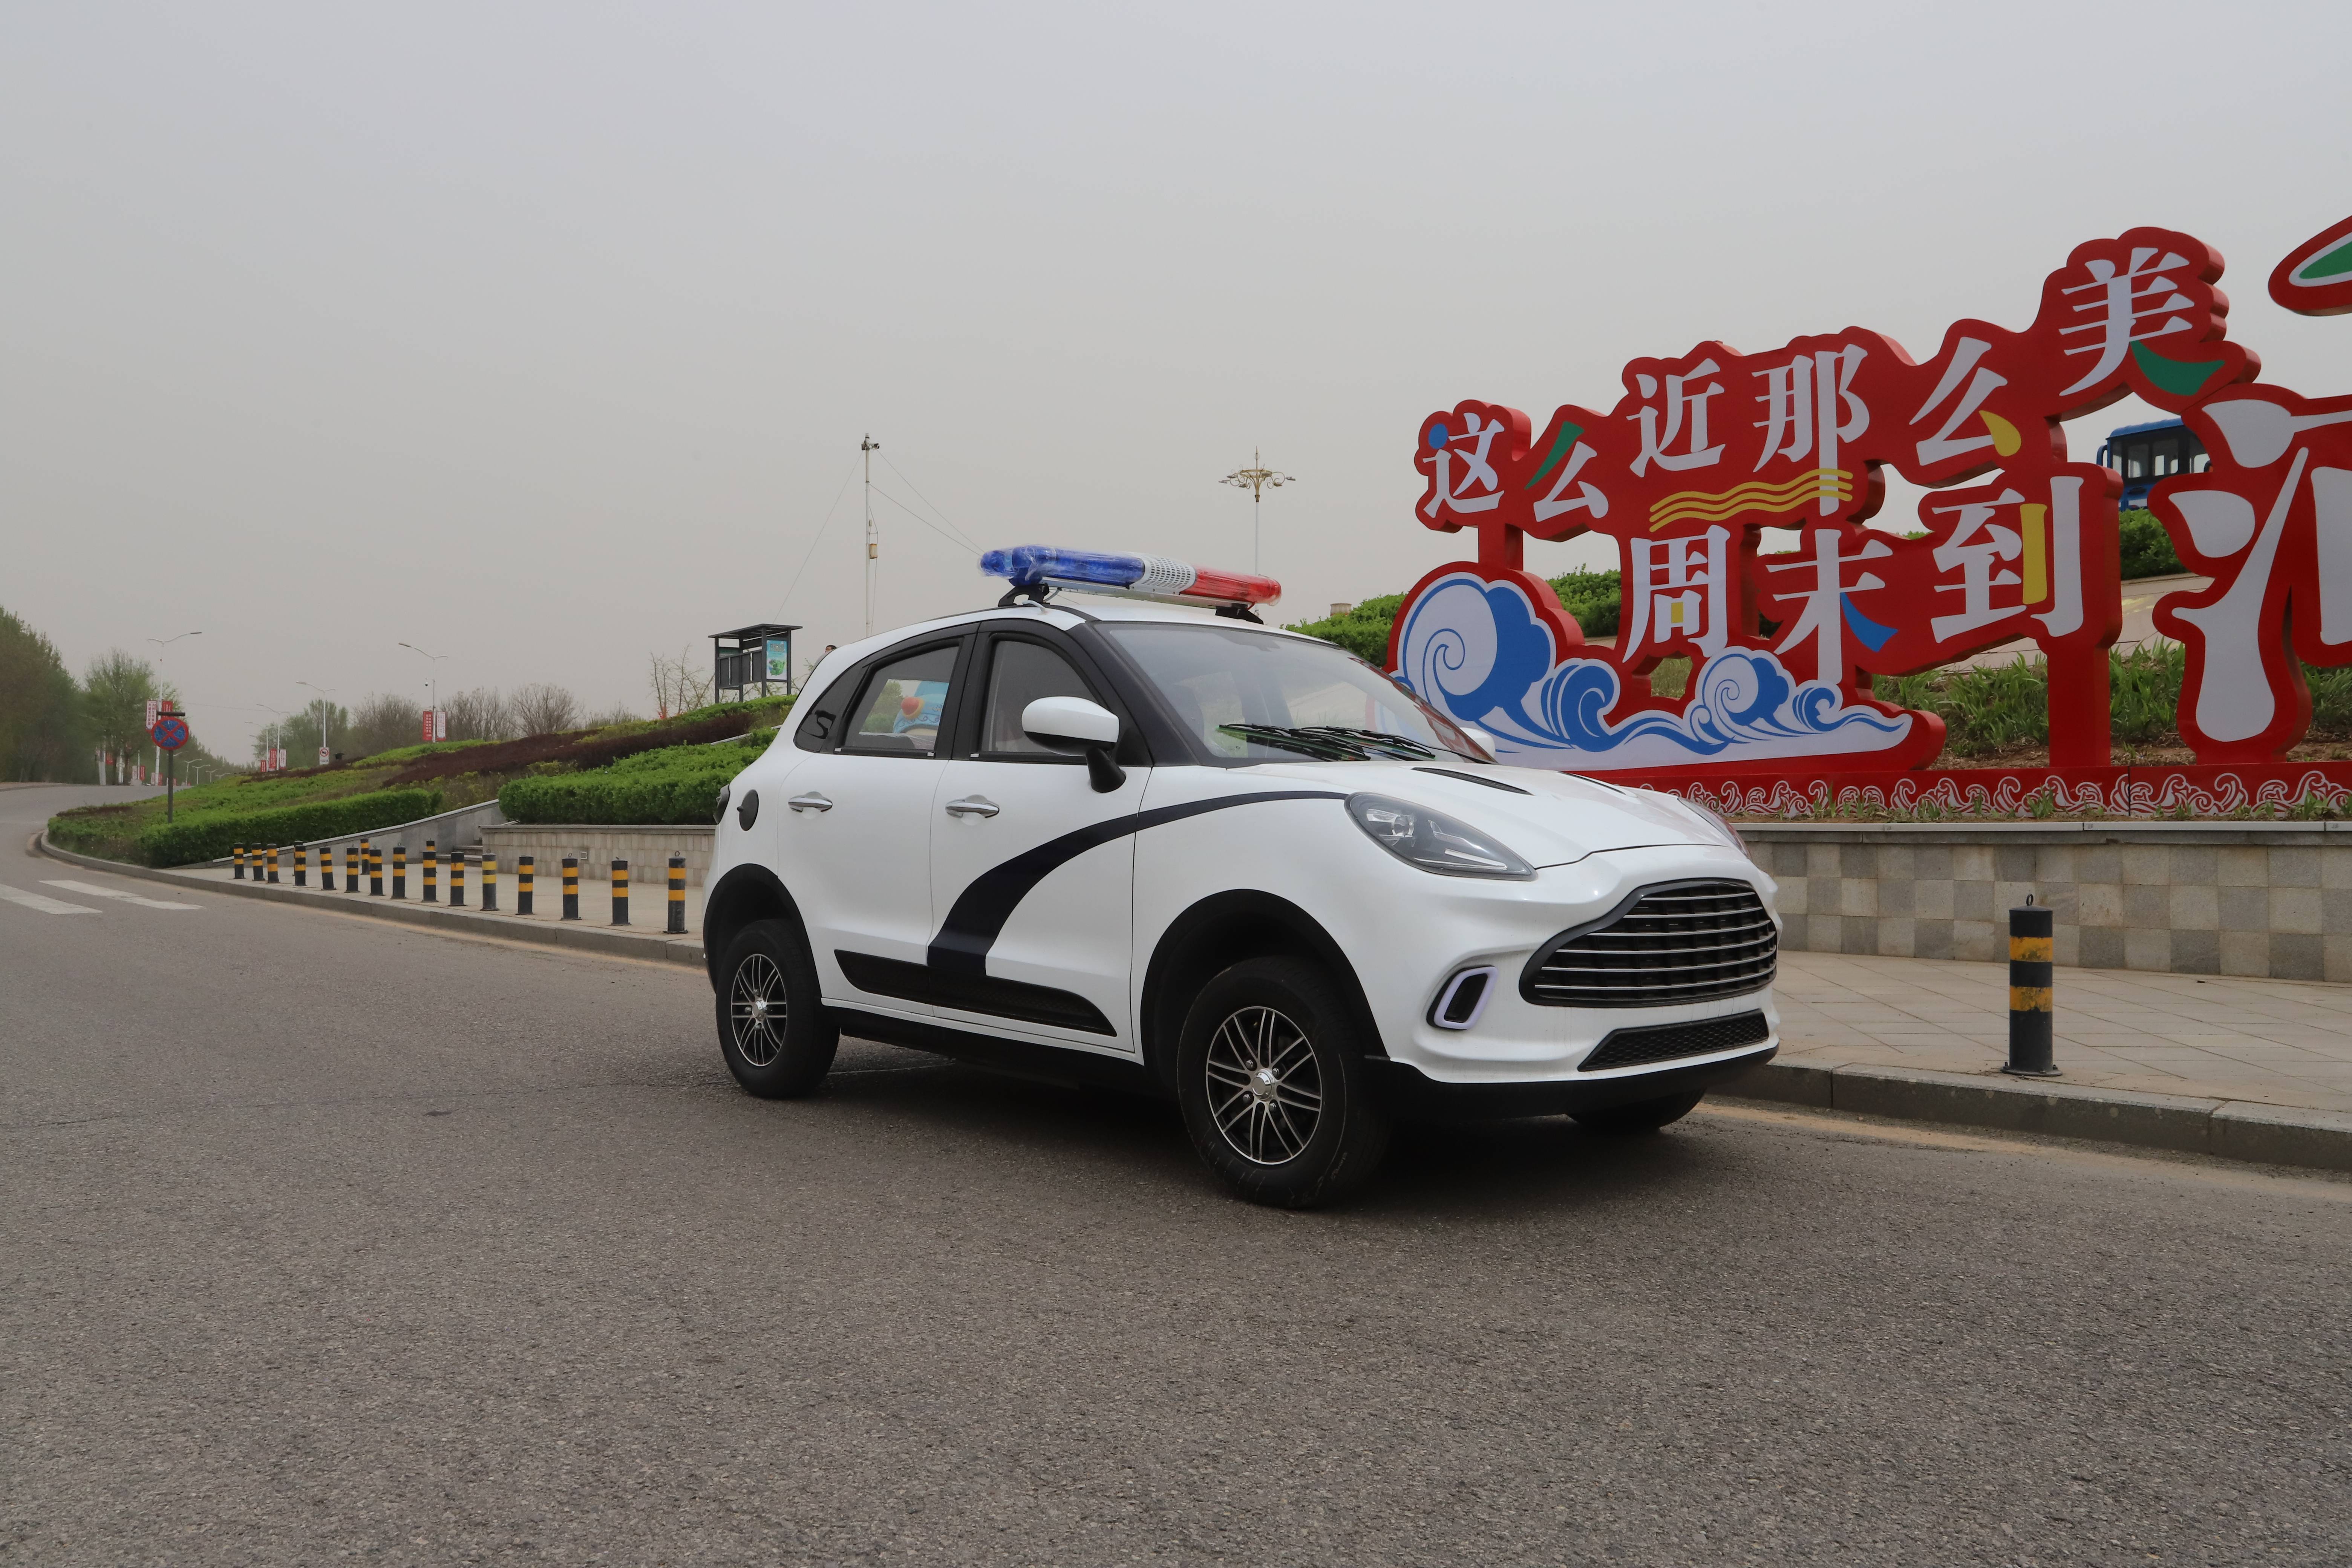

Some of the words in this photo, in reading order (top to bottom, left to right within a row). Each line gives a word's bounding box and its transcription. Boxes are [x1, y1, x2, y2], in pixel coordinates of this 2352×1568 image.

[1423, 247, 2225, 522] 这么近那么美
